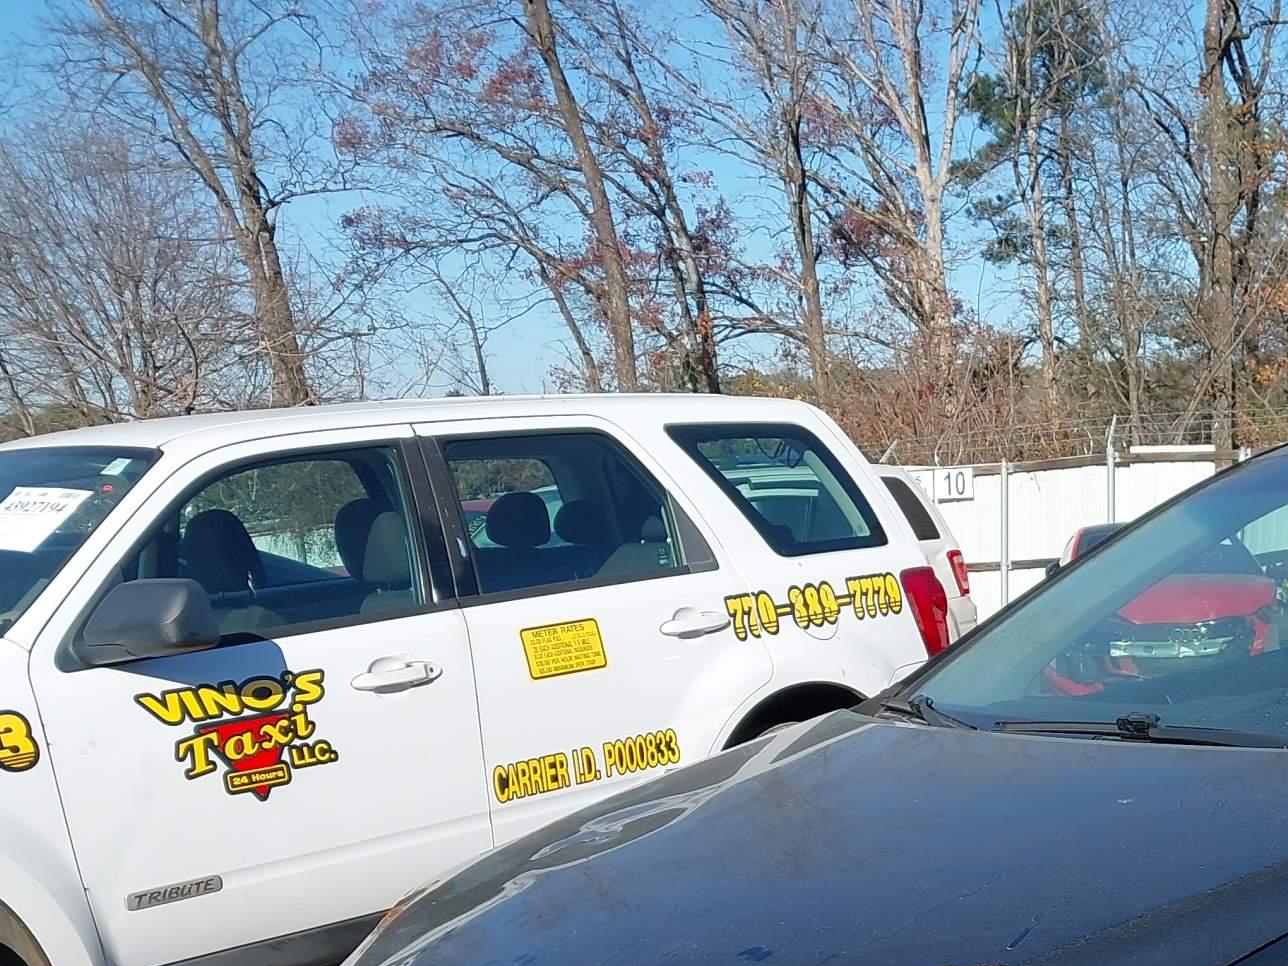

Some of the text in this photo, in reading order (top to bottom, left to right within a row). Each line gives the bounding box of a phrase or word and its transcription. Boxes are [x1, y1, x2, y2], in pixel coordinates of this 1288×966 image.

[944, 472, 965, 495] 10
[531, 624, 585, 638] METER RATES
[135, 669, 324, 725] VINO'S
[177, 702, 315, 778] Taxi
[291, 742, 337, 767] LLC.
[493, 728, 680, 803] CARRIER I.D. P000833
[232, 769, 284, 786] 24 Hours
[134, 878, 216, 909] TRIBUTE
